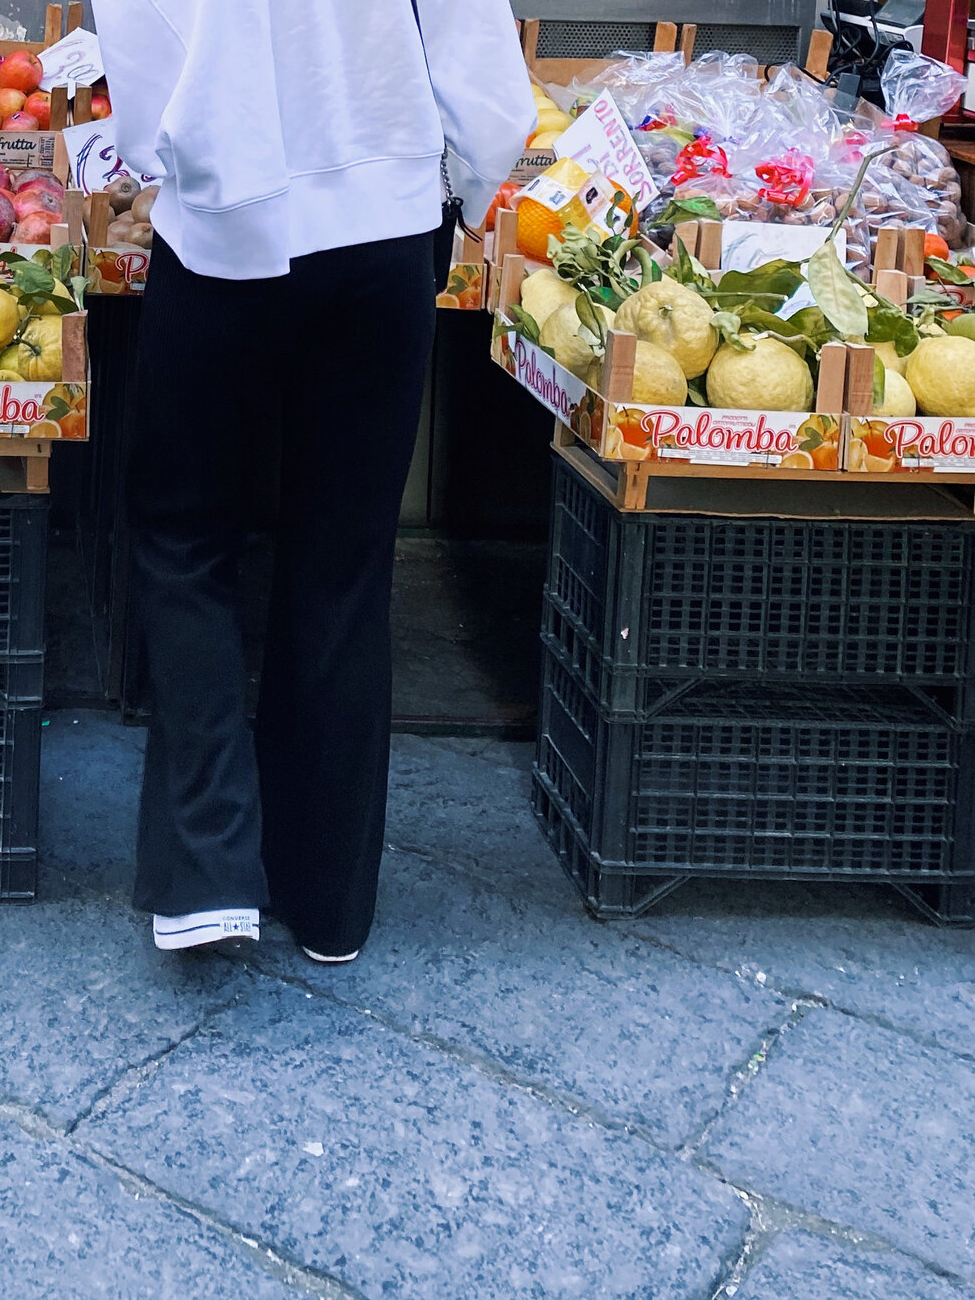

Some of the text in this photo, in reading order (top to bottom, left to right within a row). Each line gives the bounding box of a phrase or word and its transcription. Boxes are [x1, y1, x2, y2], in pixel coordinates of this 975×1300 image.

[594, 99, 652, 202] SORRENTO
[514, 338, 572, 420] Palomba
[640, 410, 800, 453] Palomba
[883, 420, 975, 459] Palo
